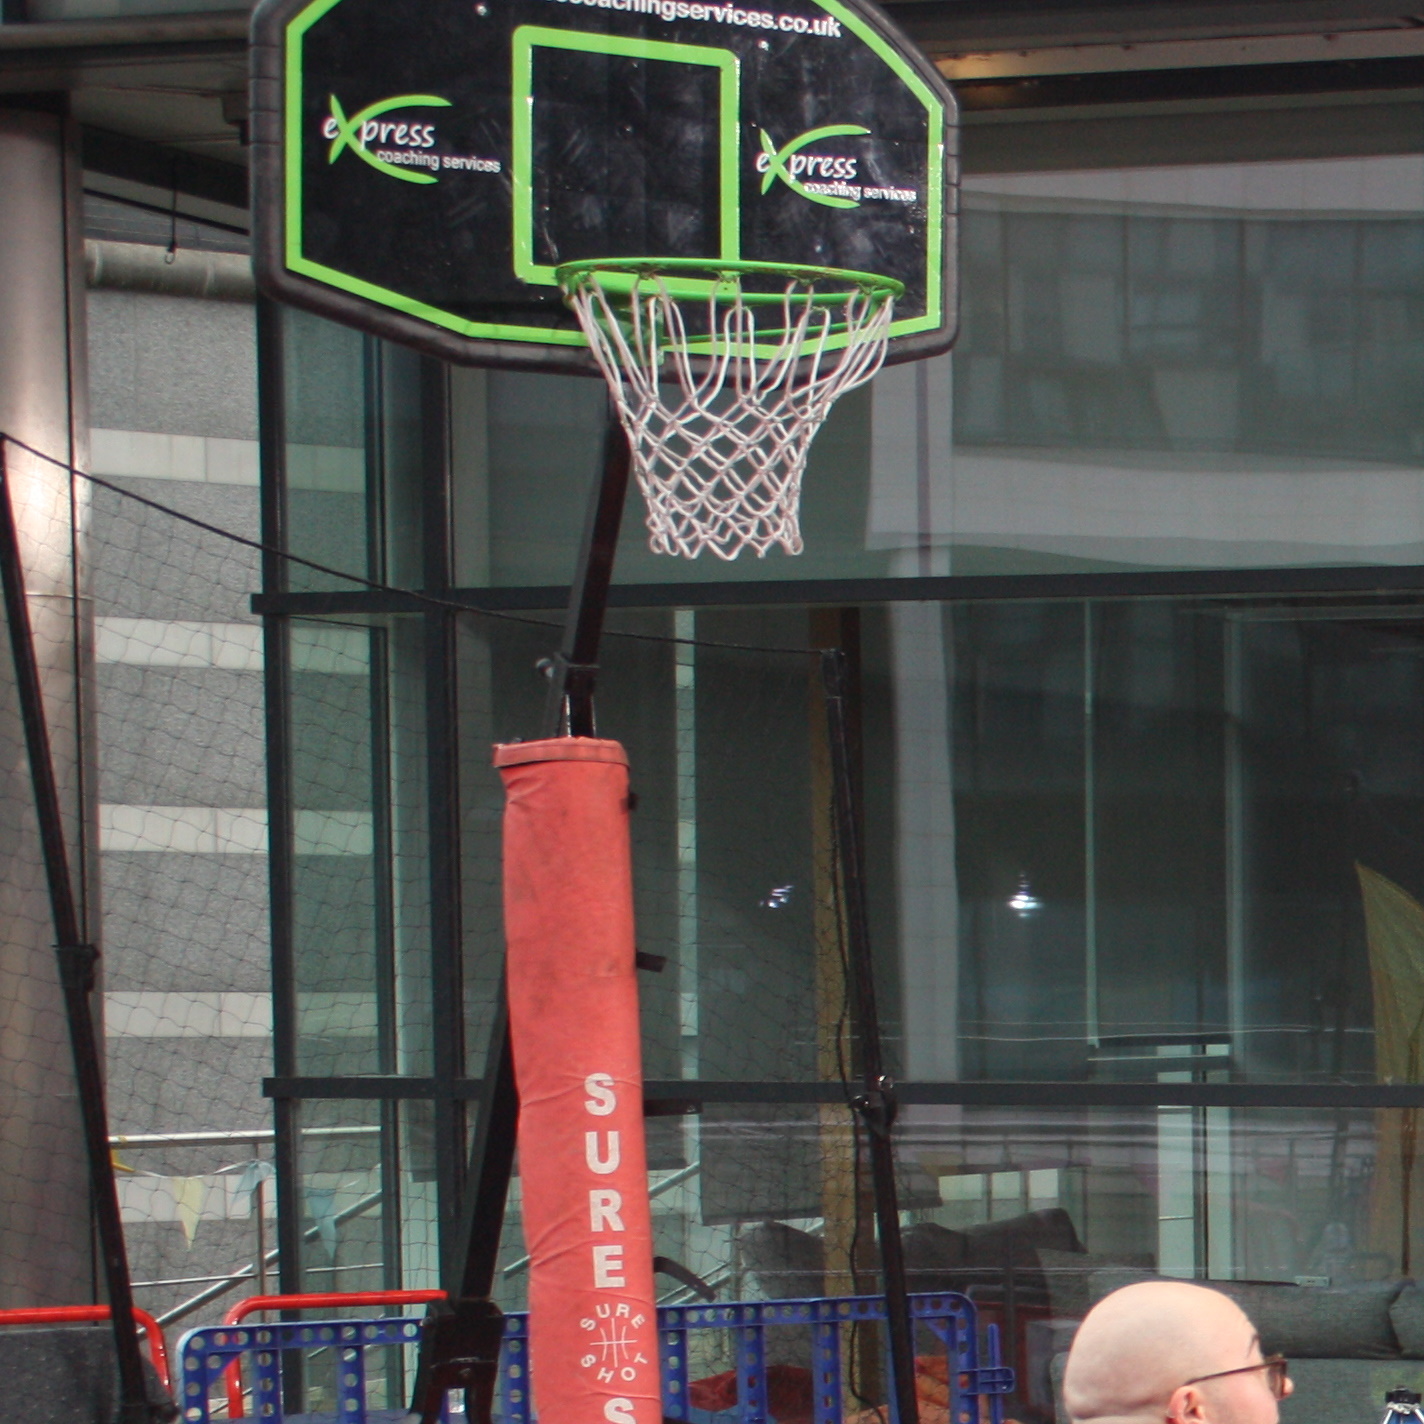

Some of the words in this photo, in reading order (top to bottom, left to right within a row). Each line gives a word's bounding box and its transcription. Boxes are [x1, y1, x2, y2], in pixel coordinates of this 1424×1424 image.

[376, 150, 440, 171] coaching
[442, 155, 502, 173] services
[803, 181, 862, 201] coaching
[584, 1072, 626, 1289] SURE
[580, 1302, 646, 1331] SURE
[580, 1352, 648, 1384] SHOT
